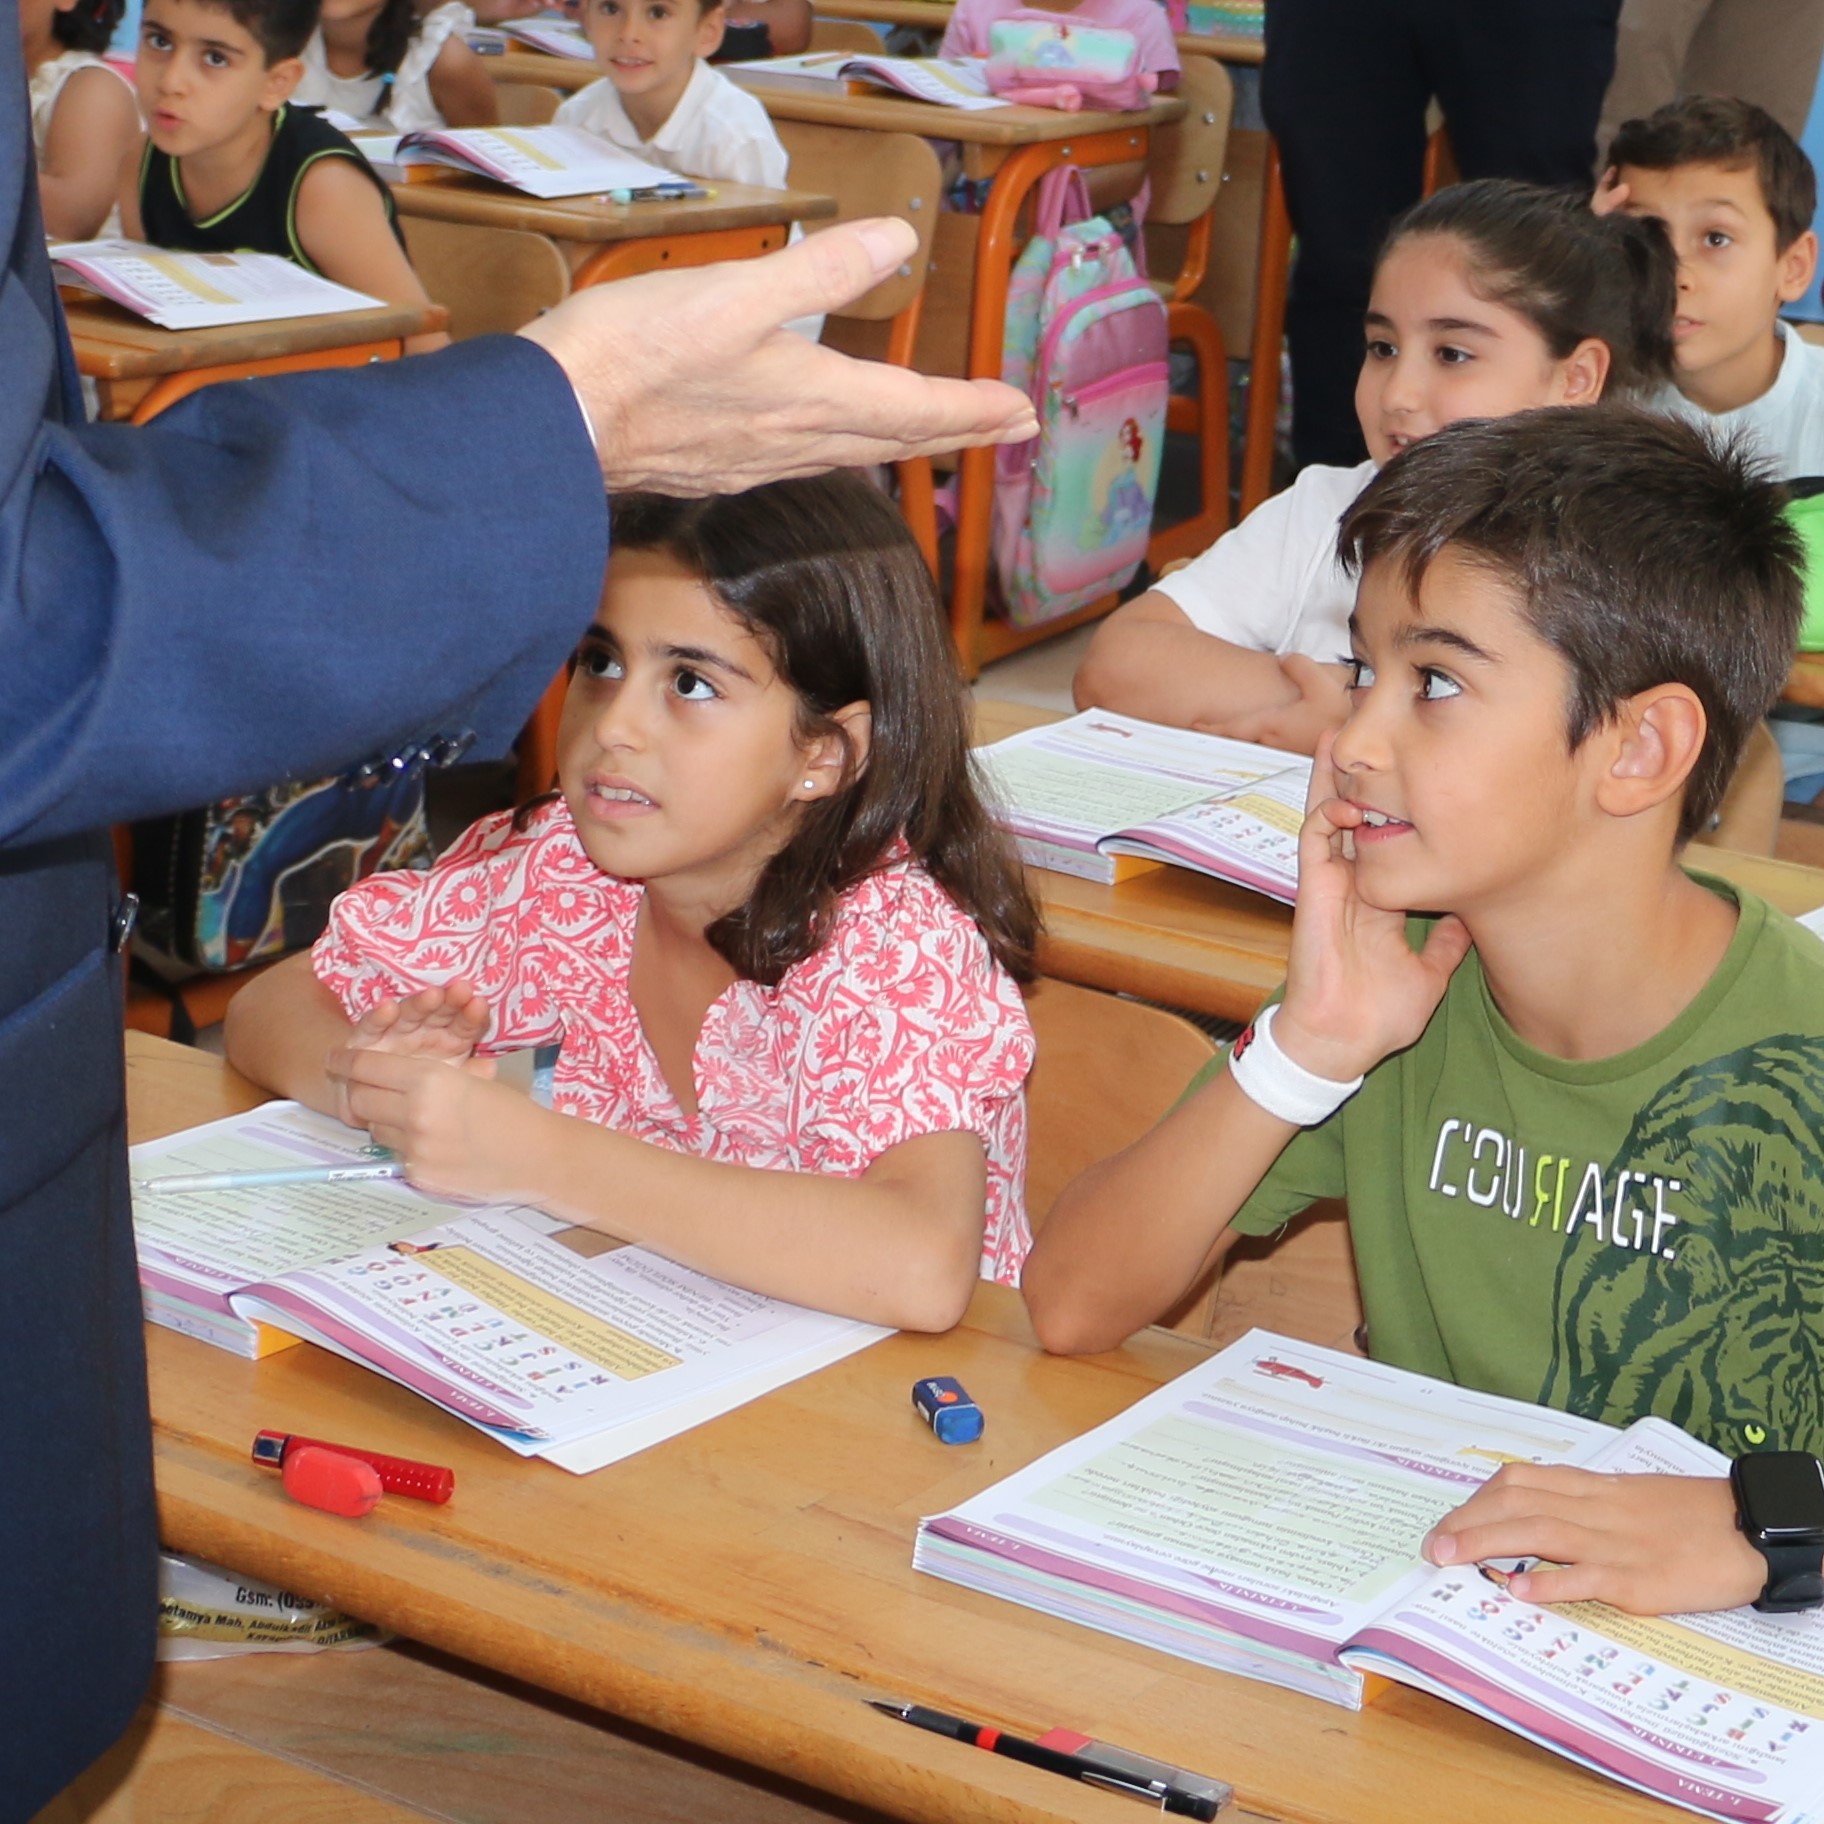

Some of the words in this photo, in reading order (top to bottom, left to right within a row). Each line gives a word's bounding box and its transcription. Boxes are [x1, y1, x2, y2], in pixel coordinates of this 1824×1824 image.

[1429, 1116, 1684, 1261] COURAGE
[1296, 1574, 1333, 1590] Orhan,
[236, 1586, 273, 1608] Gsm:
[1218, 1582, 1287, 1608] ETKİNLİK
[214, 1614, 245, 1629] Mah.
[1630, 1725, 1705, 1761] ETKİNLİK
[1676, 1778, 1724, 1802] TEMA
[1729, 1795, 1741, 1806] 1.
